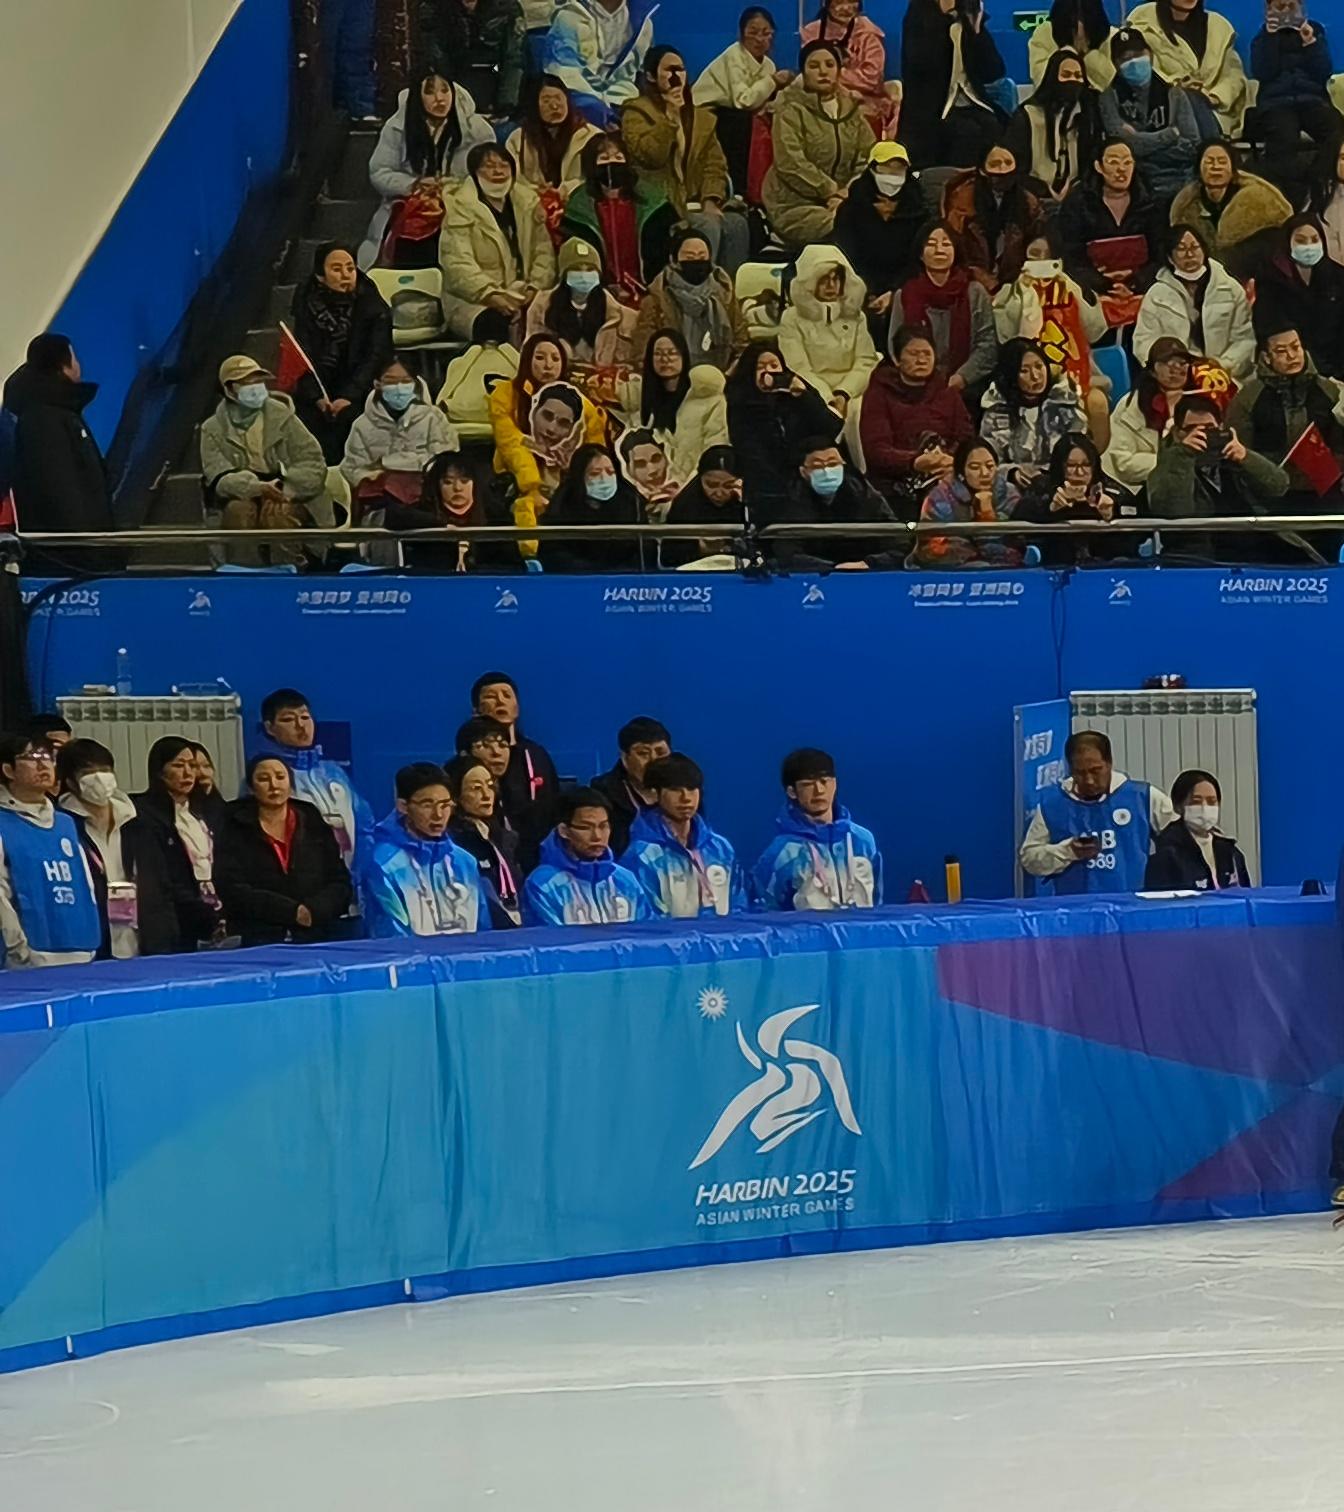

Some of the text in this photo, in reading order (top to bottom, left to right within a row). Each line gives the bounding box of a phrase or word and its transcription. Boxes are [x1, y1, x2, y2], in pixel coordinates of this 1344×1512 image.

[671, 586, 713, 602] 2025
[1219, 577, 1328, 593] HARBIN 2025
[43, 860, 72, 881] HB
[695, 1169, 855, 1207] HARBIN 2025
[696, 1197, 855, 1227] ASIAN WINTER GAMES
